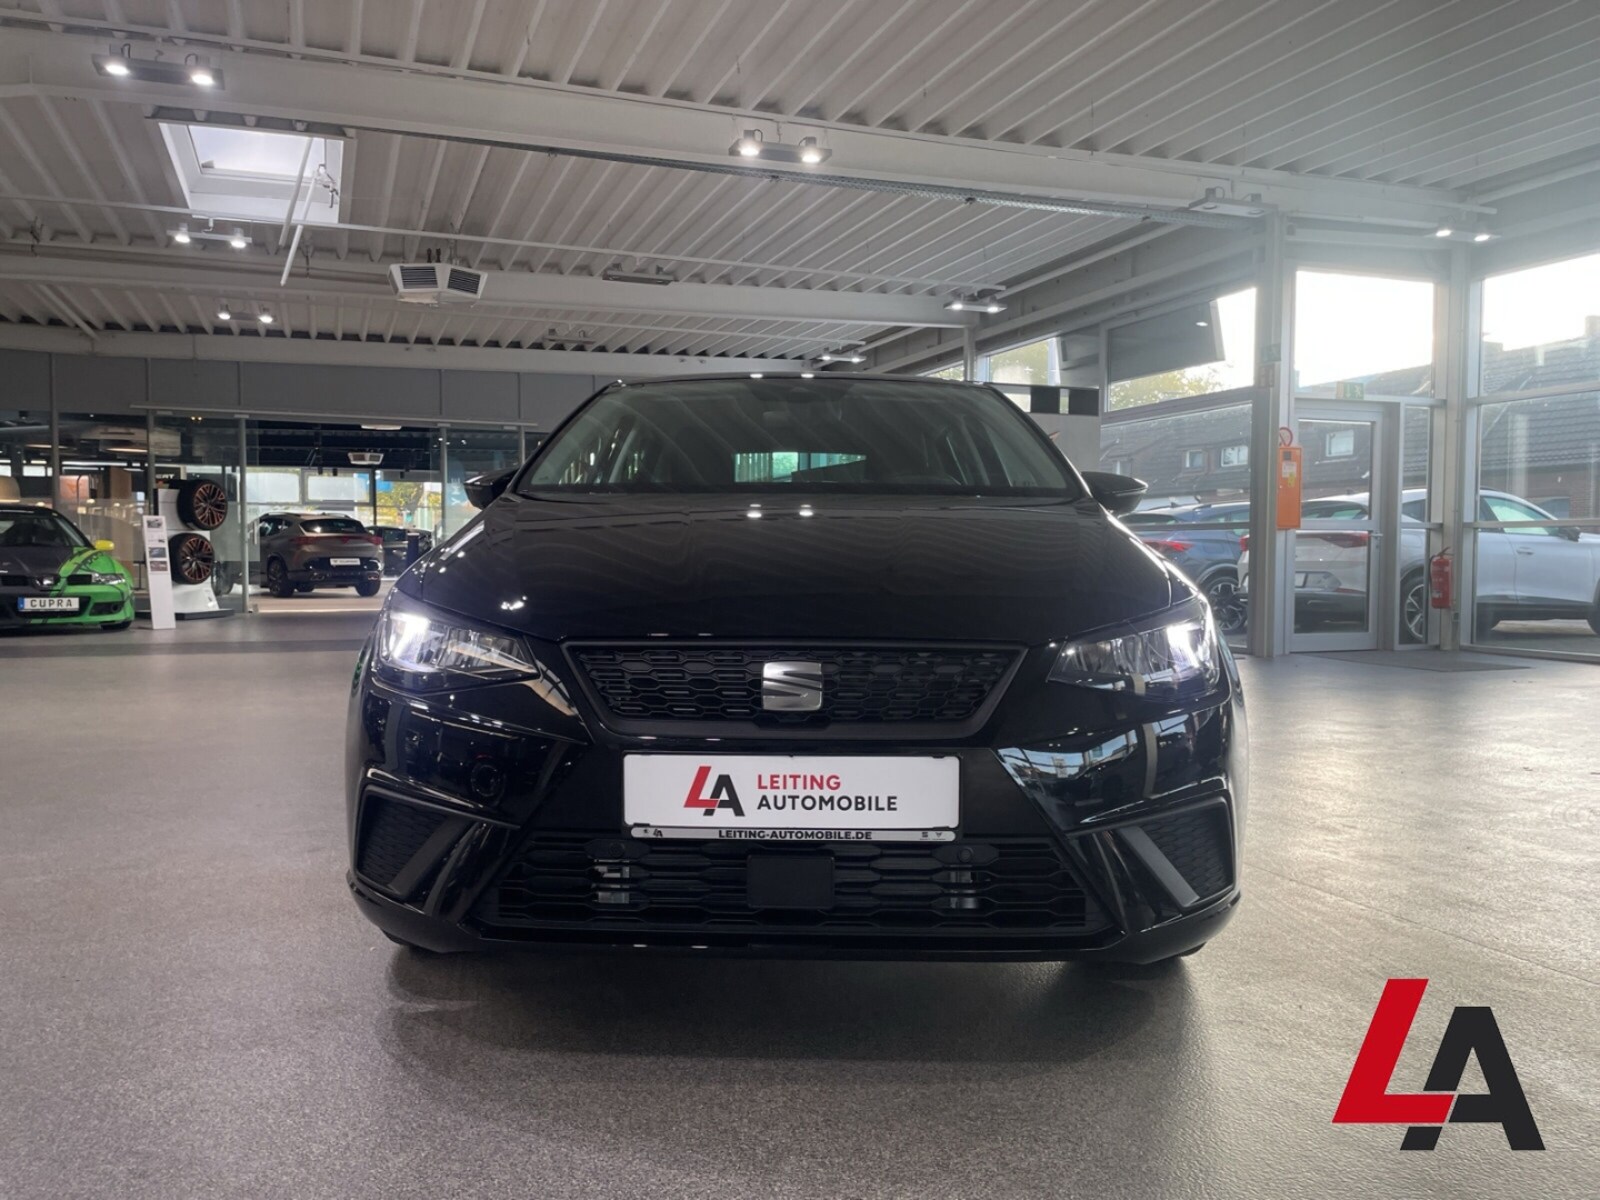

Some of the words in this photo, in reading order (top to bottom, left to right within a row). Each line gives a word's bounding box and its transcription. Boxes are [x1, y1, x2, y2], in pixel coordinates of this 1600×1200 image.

[30, 599, 73, 608] CUPRA
[757, 774, 841, 790] LEITING
[683, 766, 746, 817] LA
[757, 795, 898, 811] AUTOMOBILE
[718, 829, 873, 840] LEITING-AUTOMOBILE.DE
